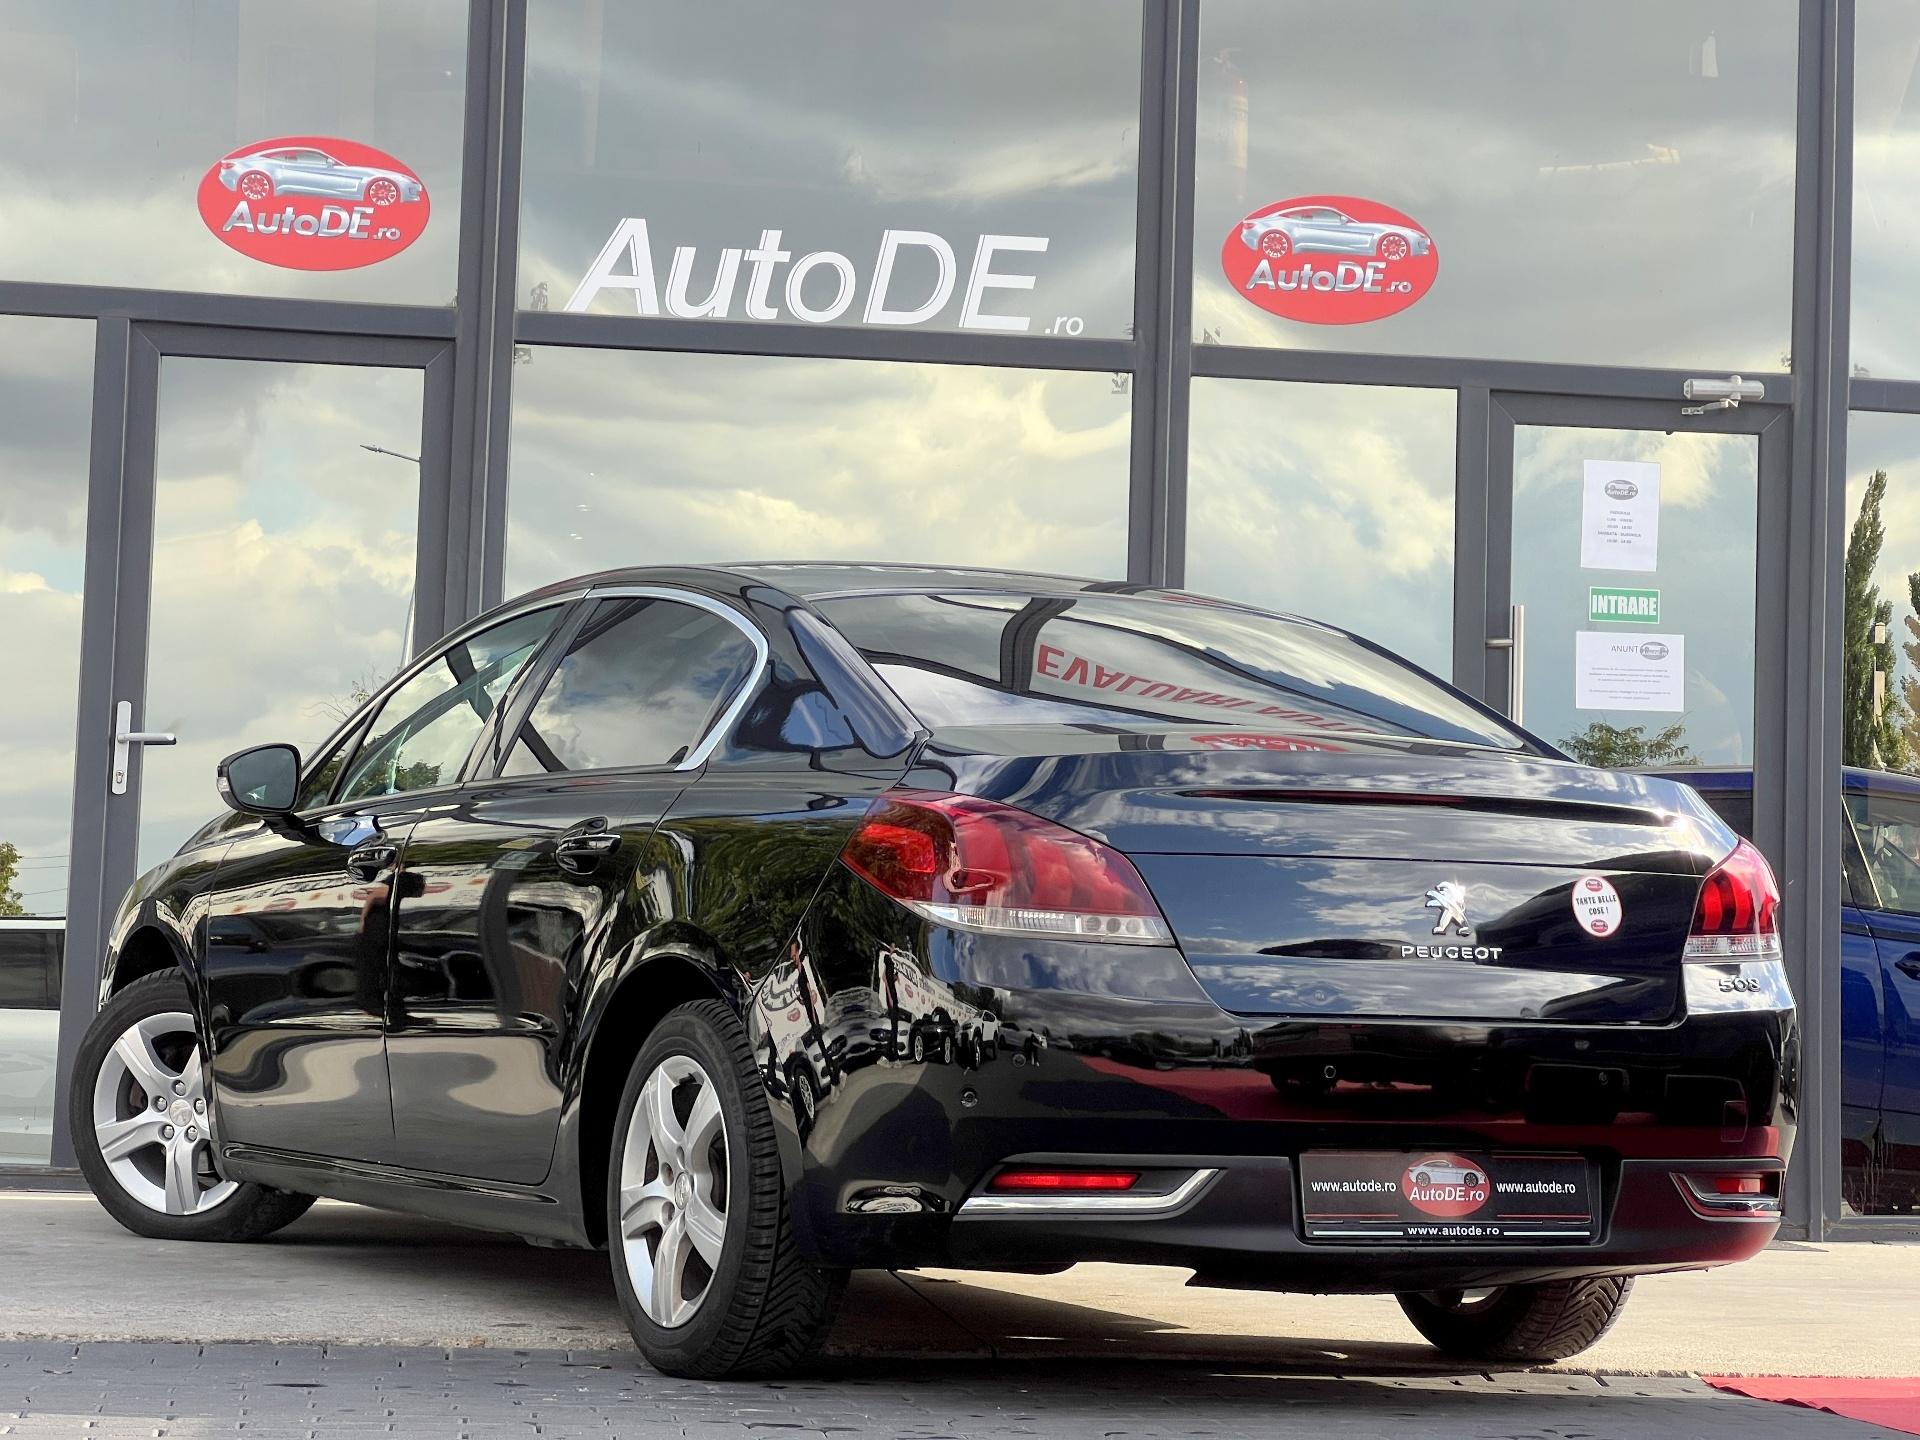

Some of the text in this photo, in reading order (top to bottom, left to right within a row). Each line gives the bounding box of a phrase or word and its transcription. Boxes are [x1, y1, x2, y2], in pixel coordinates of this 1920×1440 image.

[1592, 595, 1657, 615] INTRARE
[1611, 643, 1639, 653] ANUNT
[1576, 895, 1616, 905] TANTE BELLE
[1589, 907, 1604, 915] COSE
[1401, 945, 1503, 960] PEUGEOT
[1718, 977, 1760, 993] 508
[1311, 1180, 1397, 1193] www.autode.ro
[1496, 1181, 1576, 1194] www.autode.ro
[1409, 1187, 1485, 1202] AutoDE.ro
[1407, 1225, 1500, 1236] www.autode.ro
